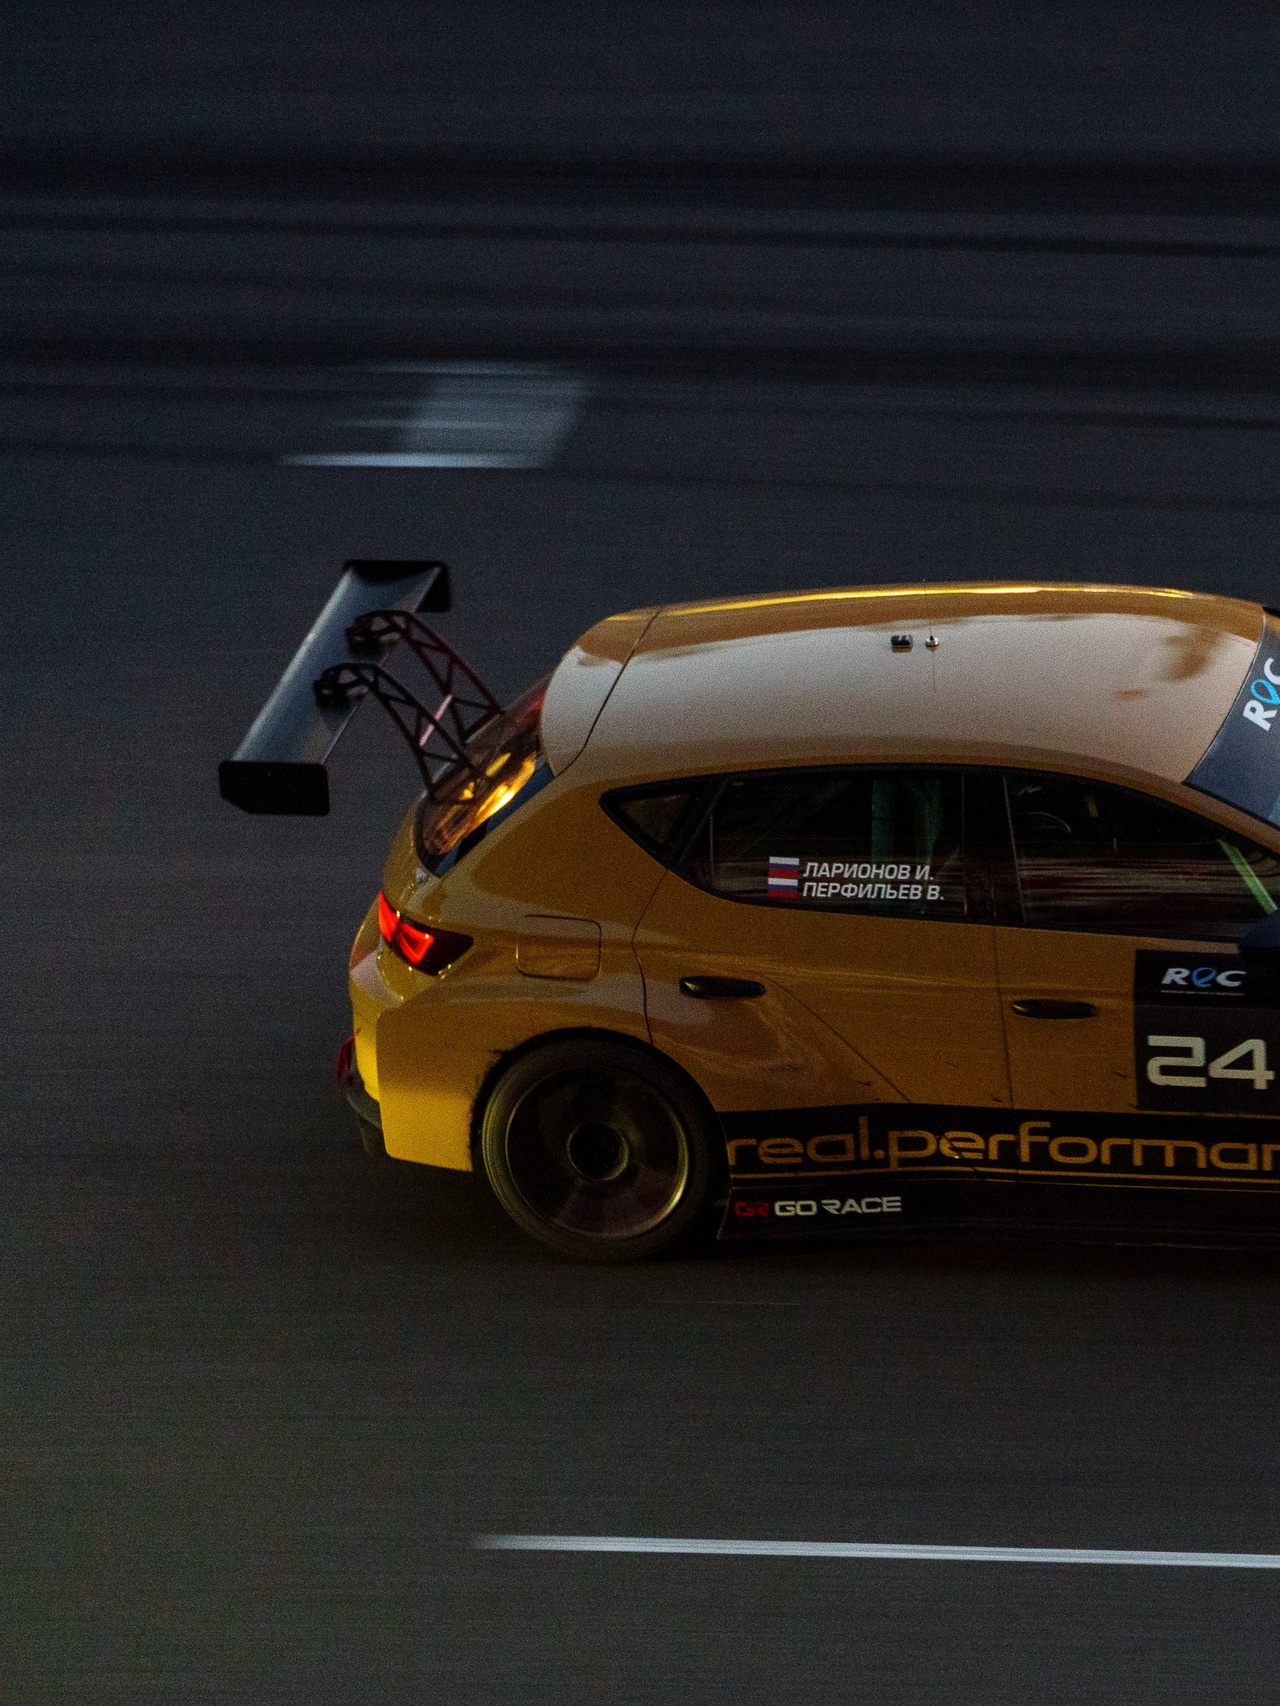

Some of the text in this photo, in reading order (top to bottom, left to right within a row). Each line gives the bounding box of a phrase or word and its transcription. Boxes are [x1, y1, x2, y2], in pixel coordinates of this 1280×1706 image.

[803, 861, 934, 881] ЛАРИОНОВ И.
[802, 881, 945, 901] ПЕРФИЛЬЕВ В.
[1146, 1034, 1276, 1091] 24
[774, 1200, 818, 1217] GO
[821, 1195, 903, 1215] RACE
